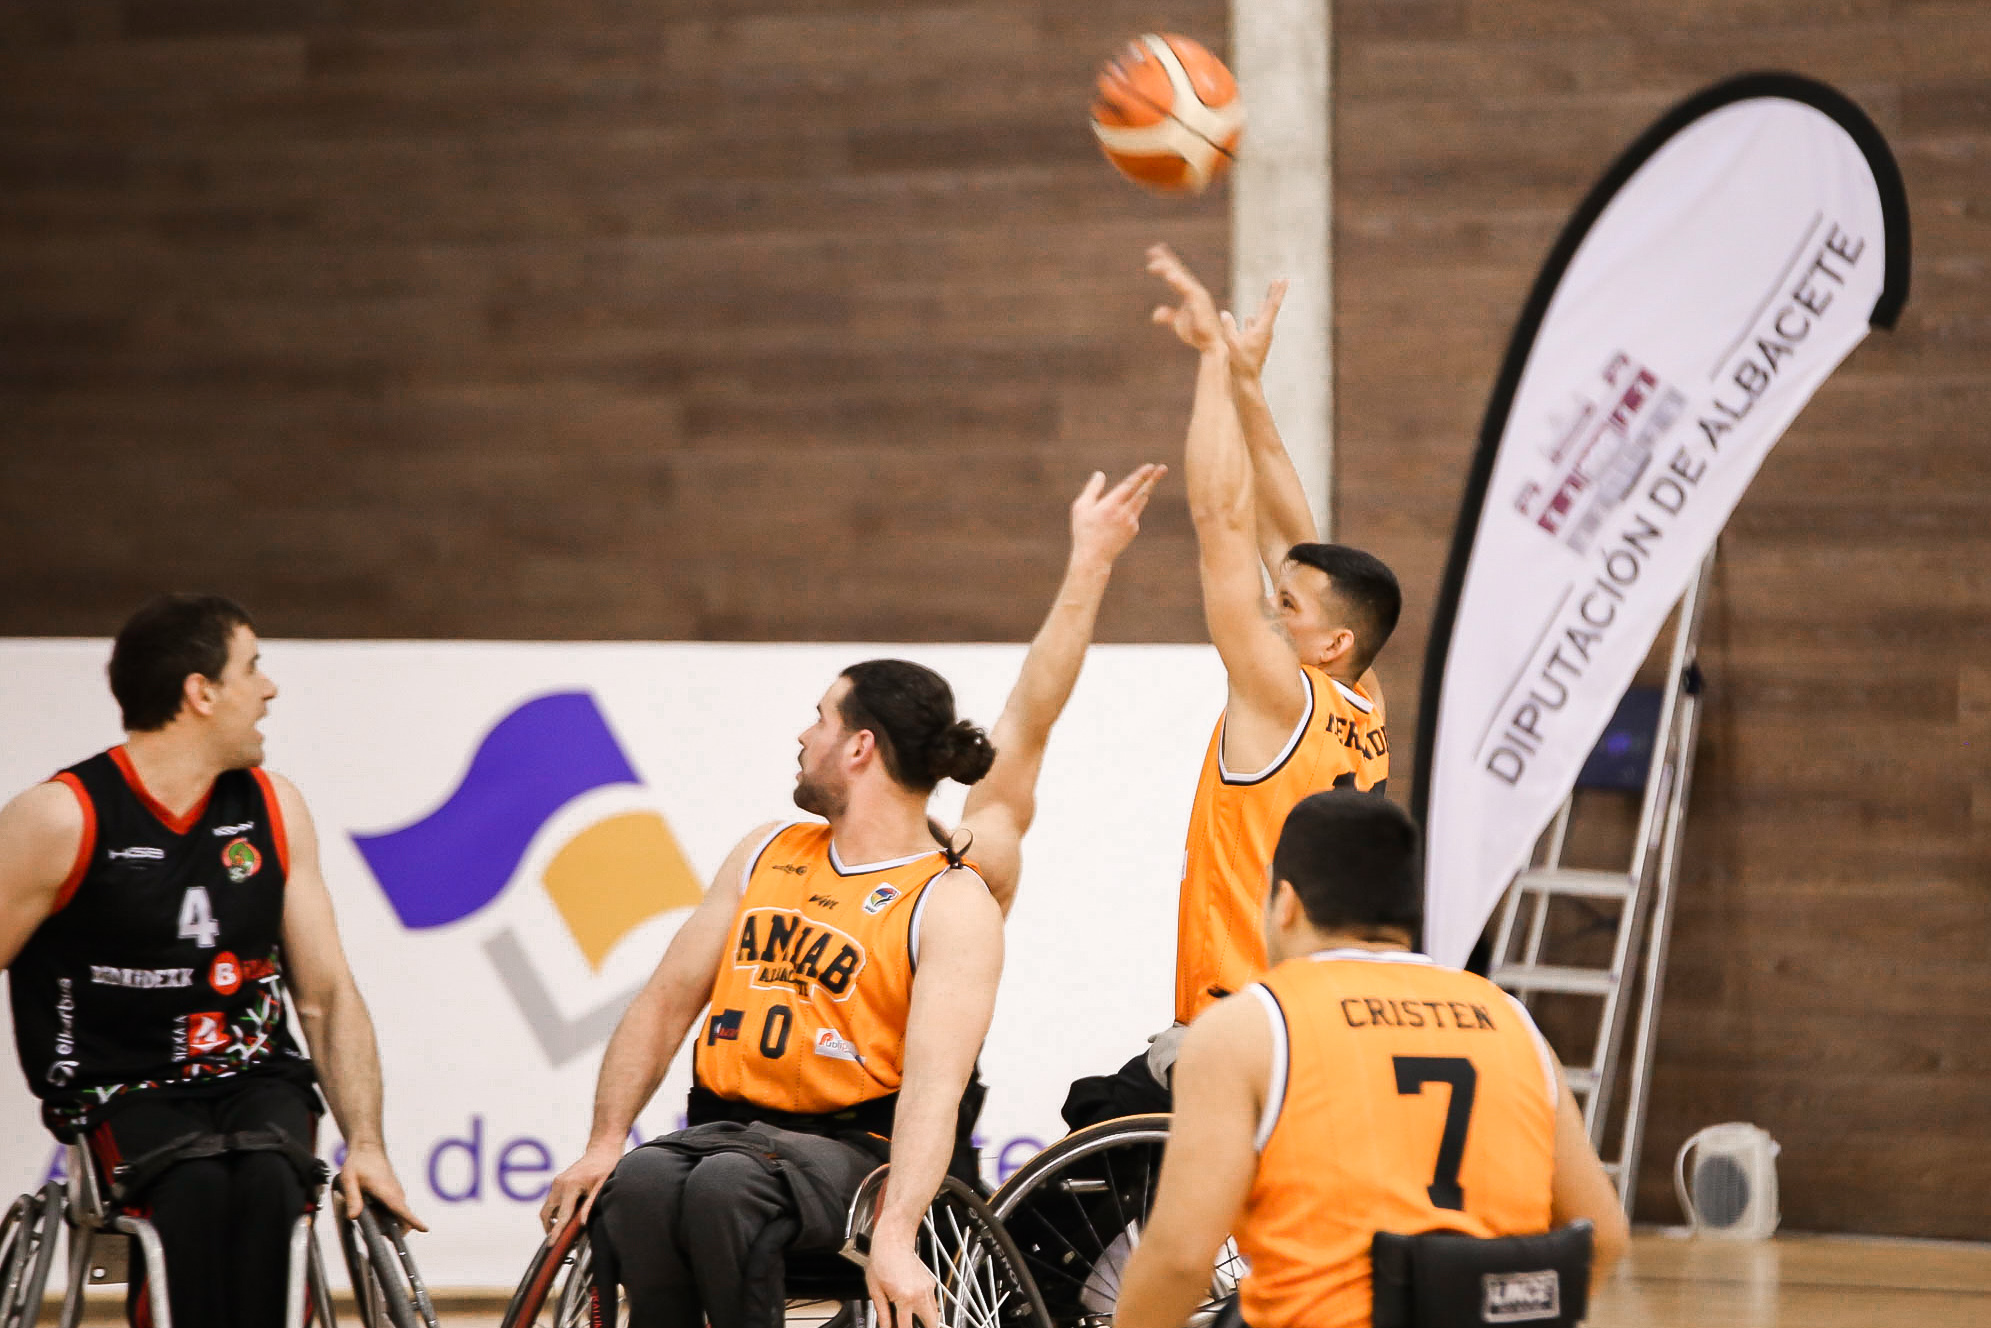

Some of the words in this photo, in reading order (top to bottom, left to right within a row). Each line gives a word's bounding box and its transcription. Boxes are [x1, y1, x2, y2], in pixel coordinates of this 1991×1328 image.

[1486, 513, 1664, 786] DIPUTACIÓN
[1650, 446, 1707, 518] DE
[1700, 221, 1866, 451] ALBACETE
[177, 886, 219, 948] 4
[760, 1004, 793, 1059] 0
[1341, 999, 1496, 1030] CRISTEN
[428, 1115, 552, 1202] de
[1392, 1056, 1476, 1211] 7
